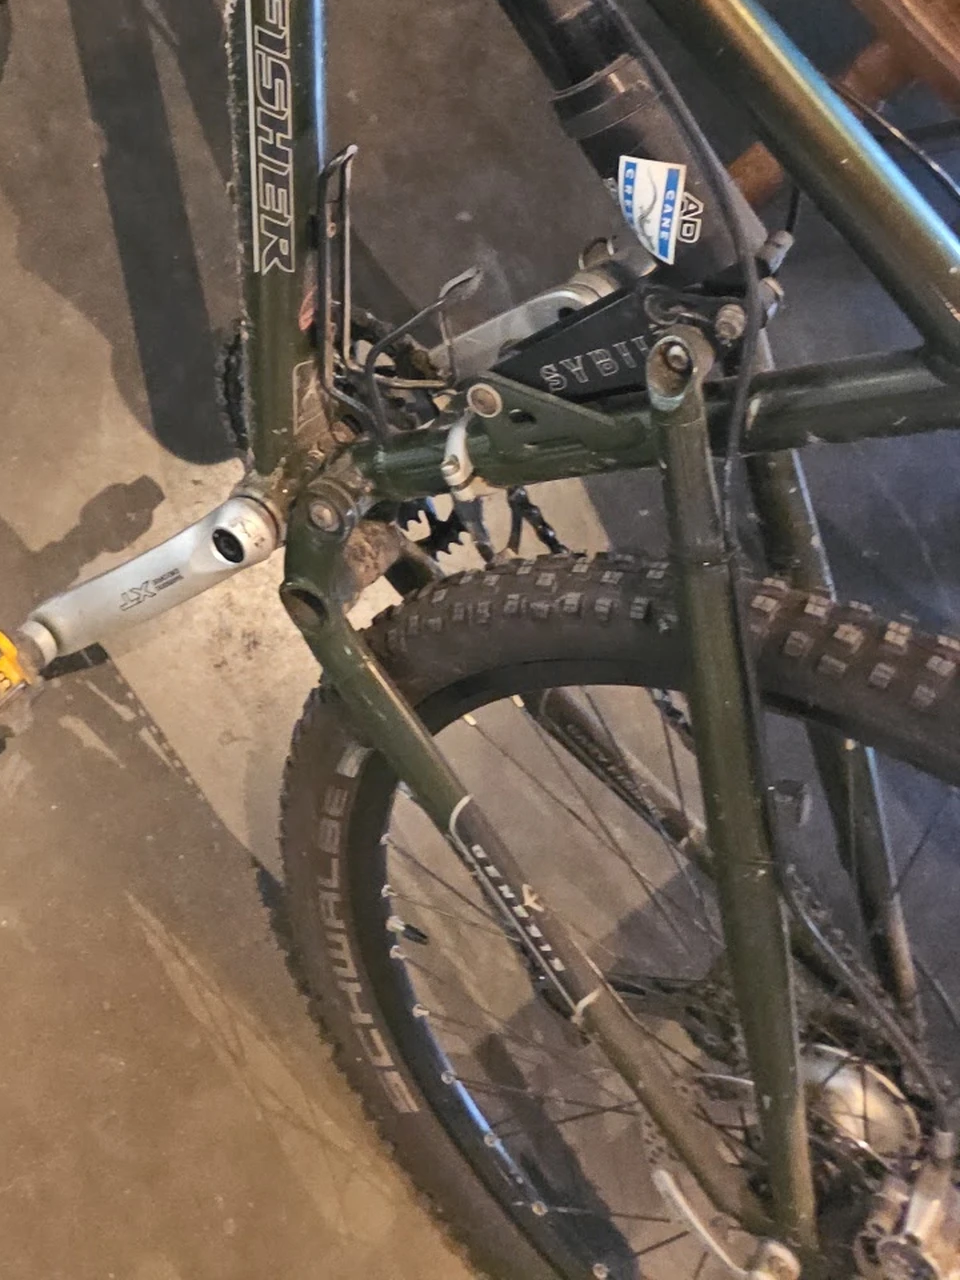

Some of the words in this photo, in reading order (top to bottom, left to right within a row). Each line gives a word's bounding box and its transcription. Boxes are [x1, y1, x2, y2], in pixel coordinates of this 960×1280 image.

[659, 190, 676, 240] CANE
[119, 579, 157, 612] XT
[318, 784, 420, 1113] SCHWALBE
